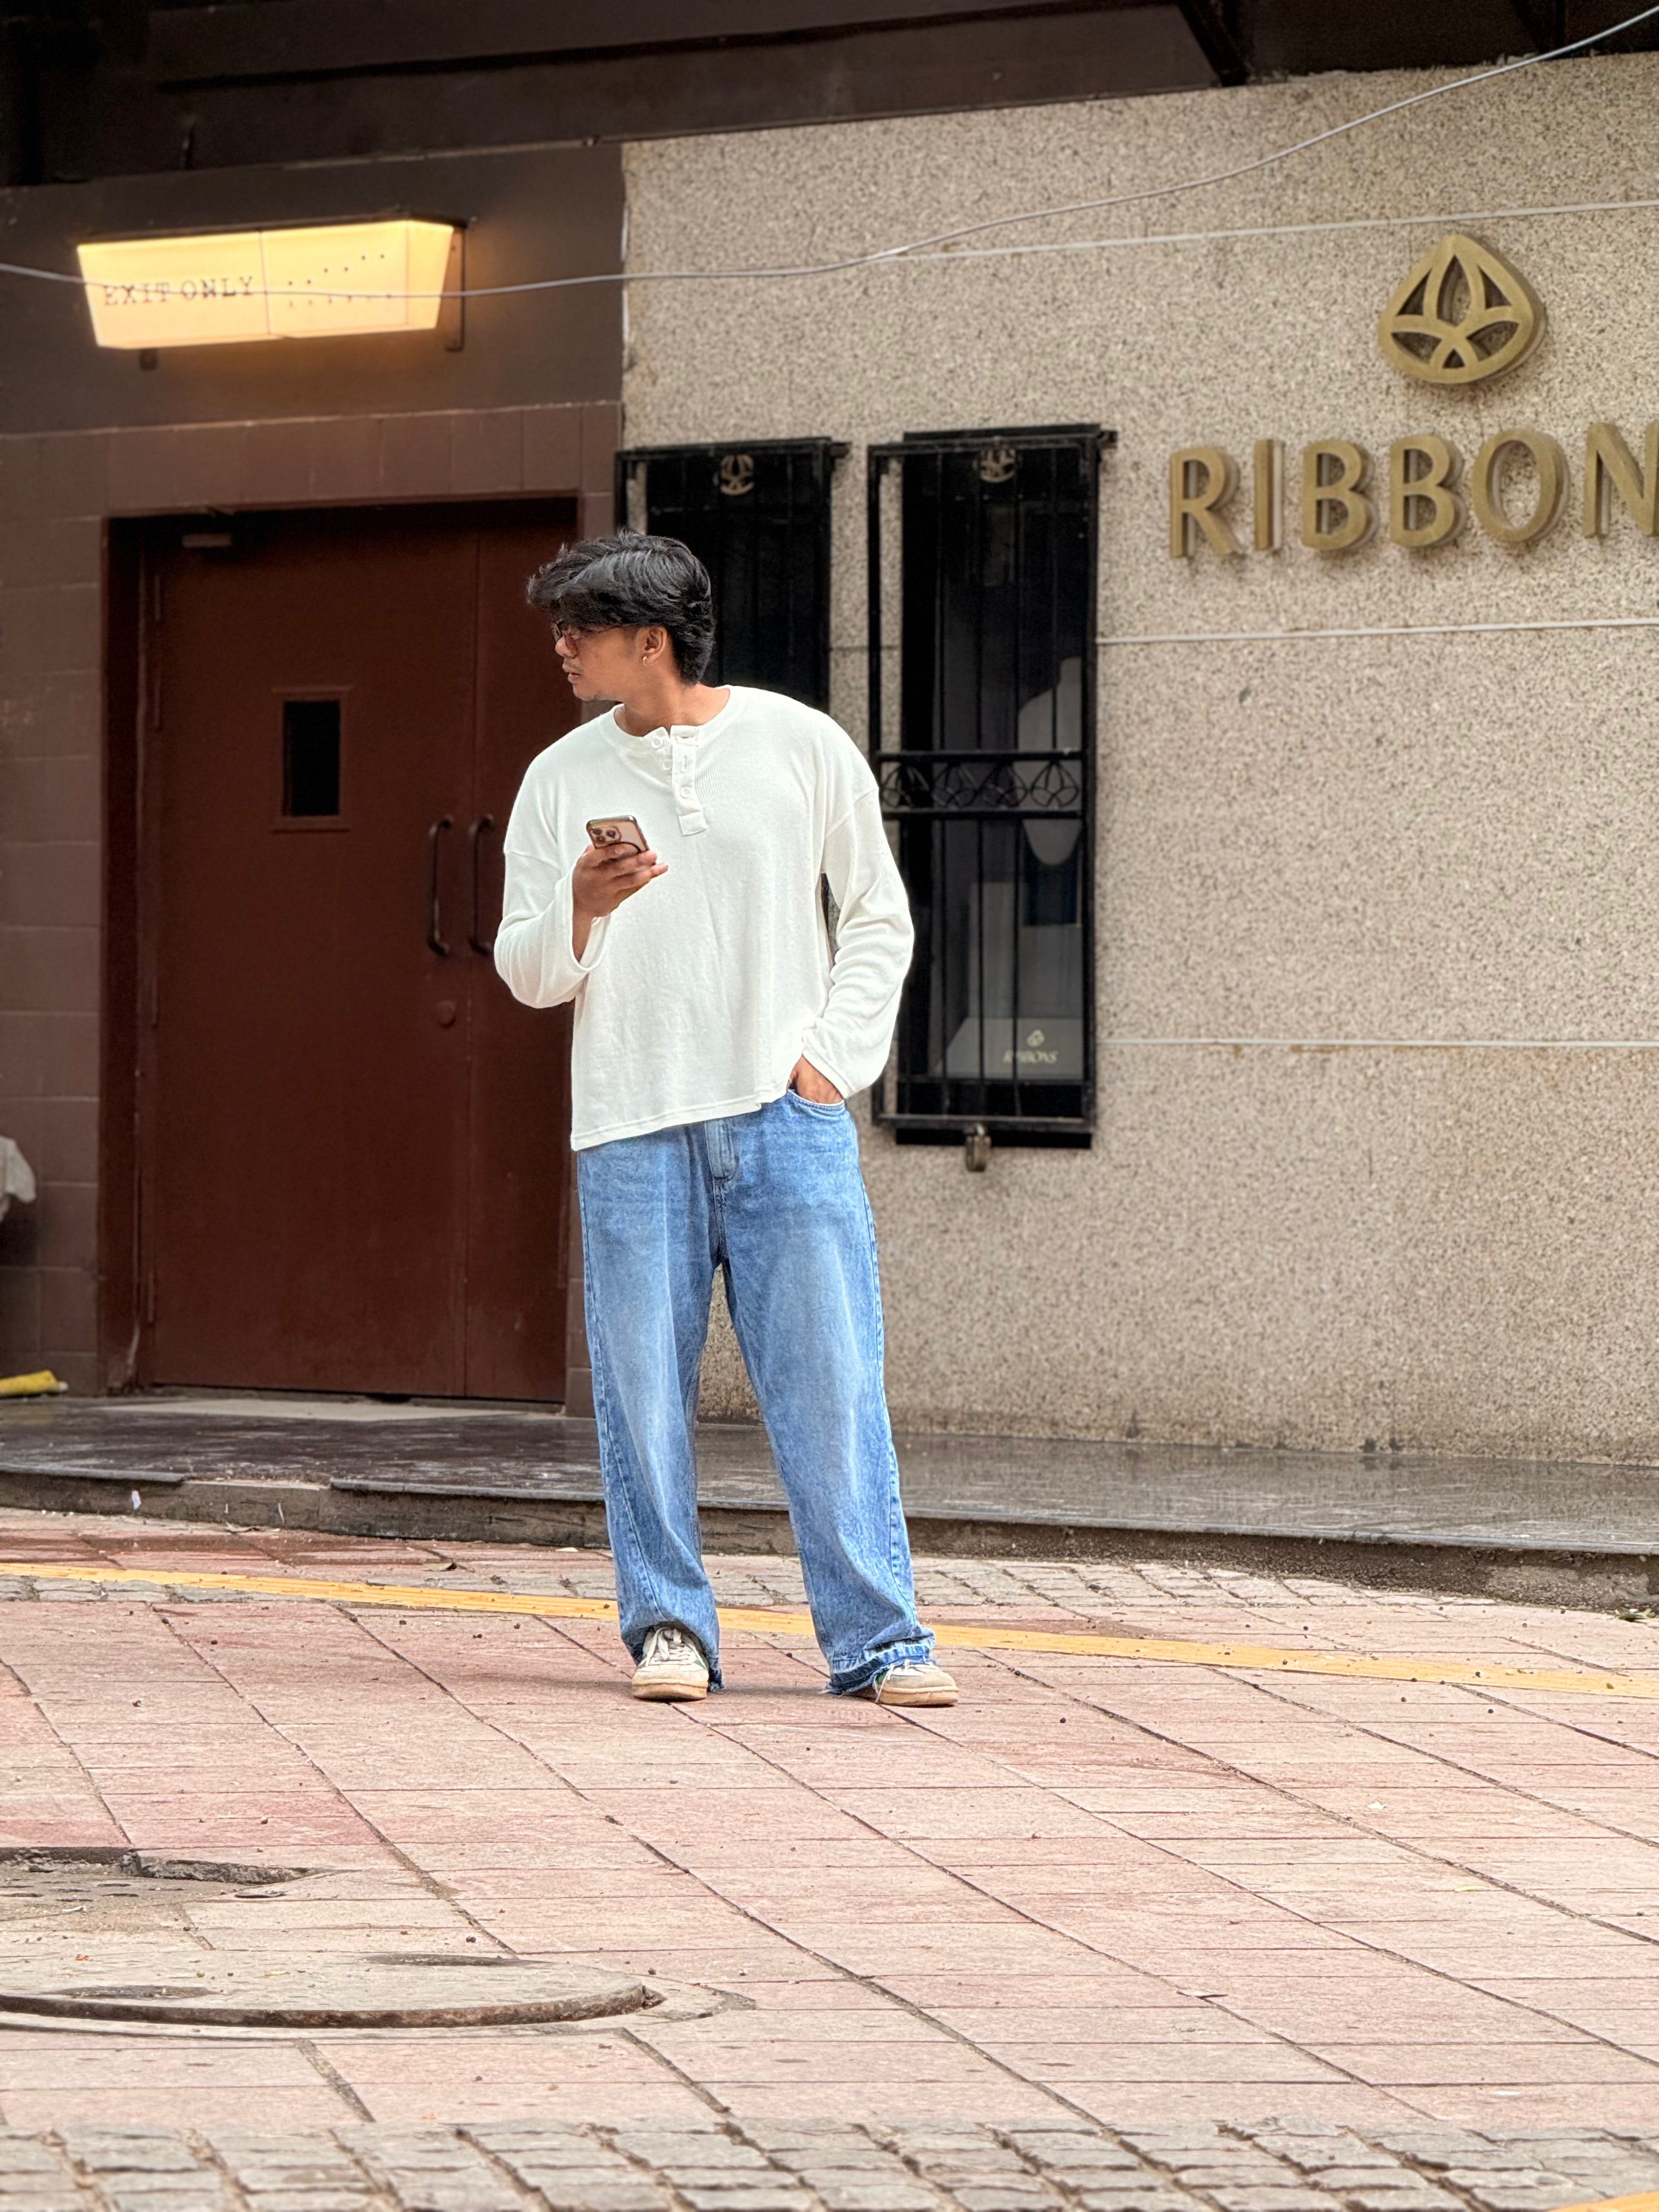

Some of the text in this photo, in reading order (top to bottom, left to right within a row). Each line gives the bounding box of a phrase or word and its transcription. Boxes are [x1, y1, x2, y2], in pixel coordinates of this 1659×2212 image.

[103, 275, 253, 306] EXIT ONLY
[1169, 420, 1659, 558] RIBBON
